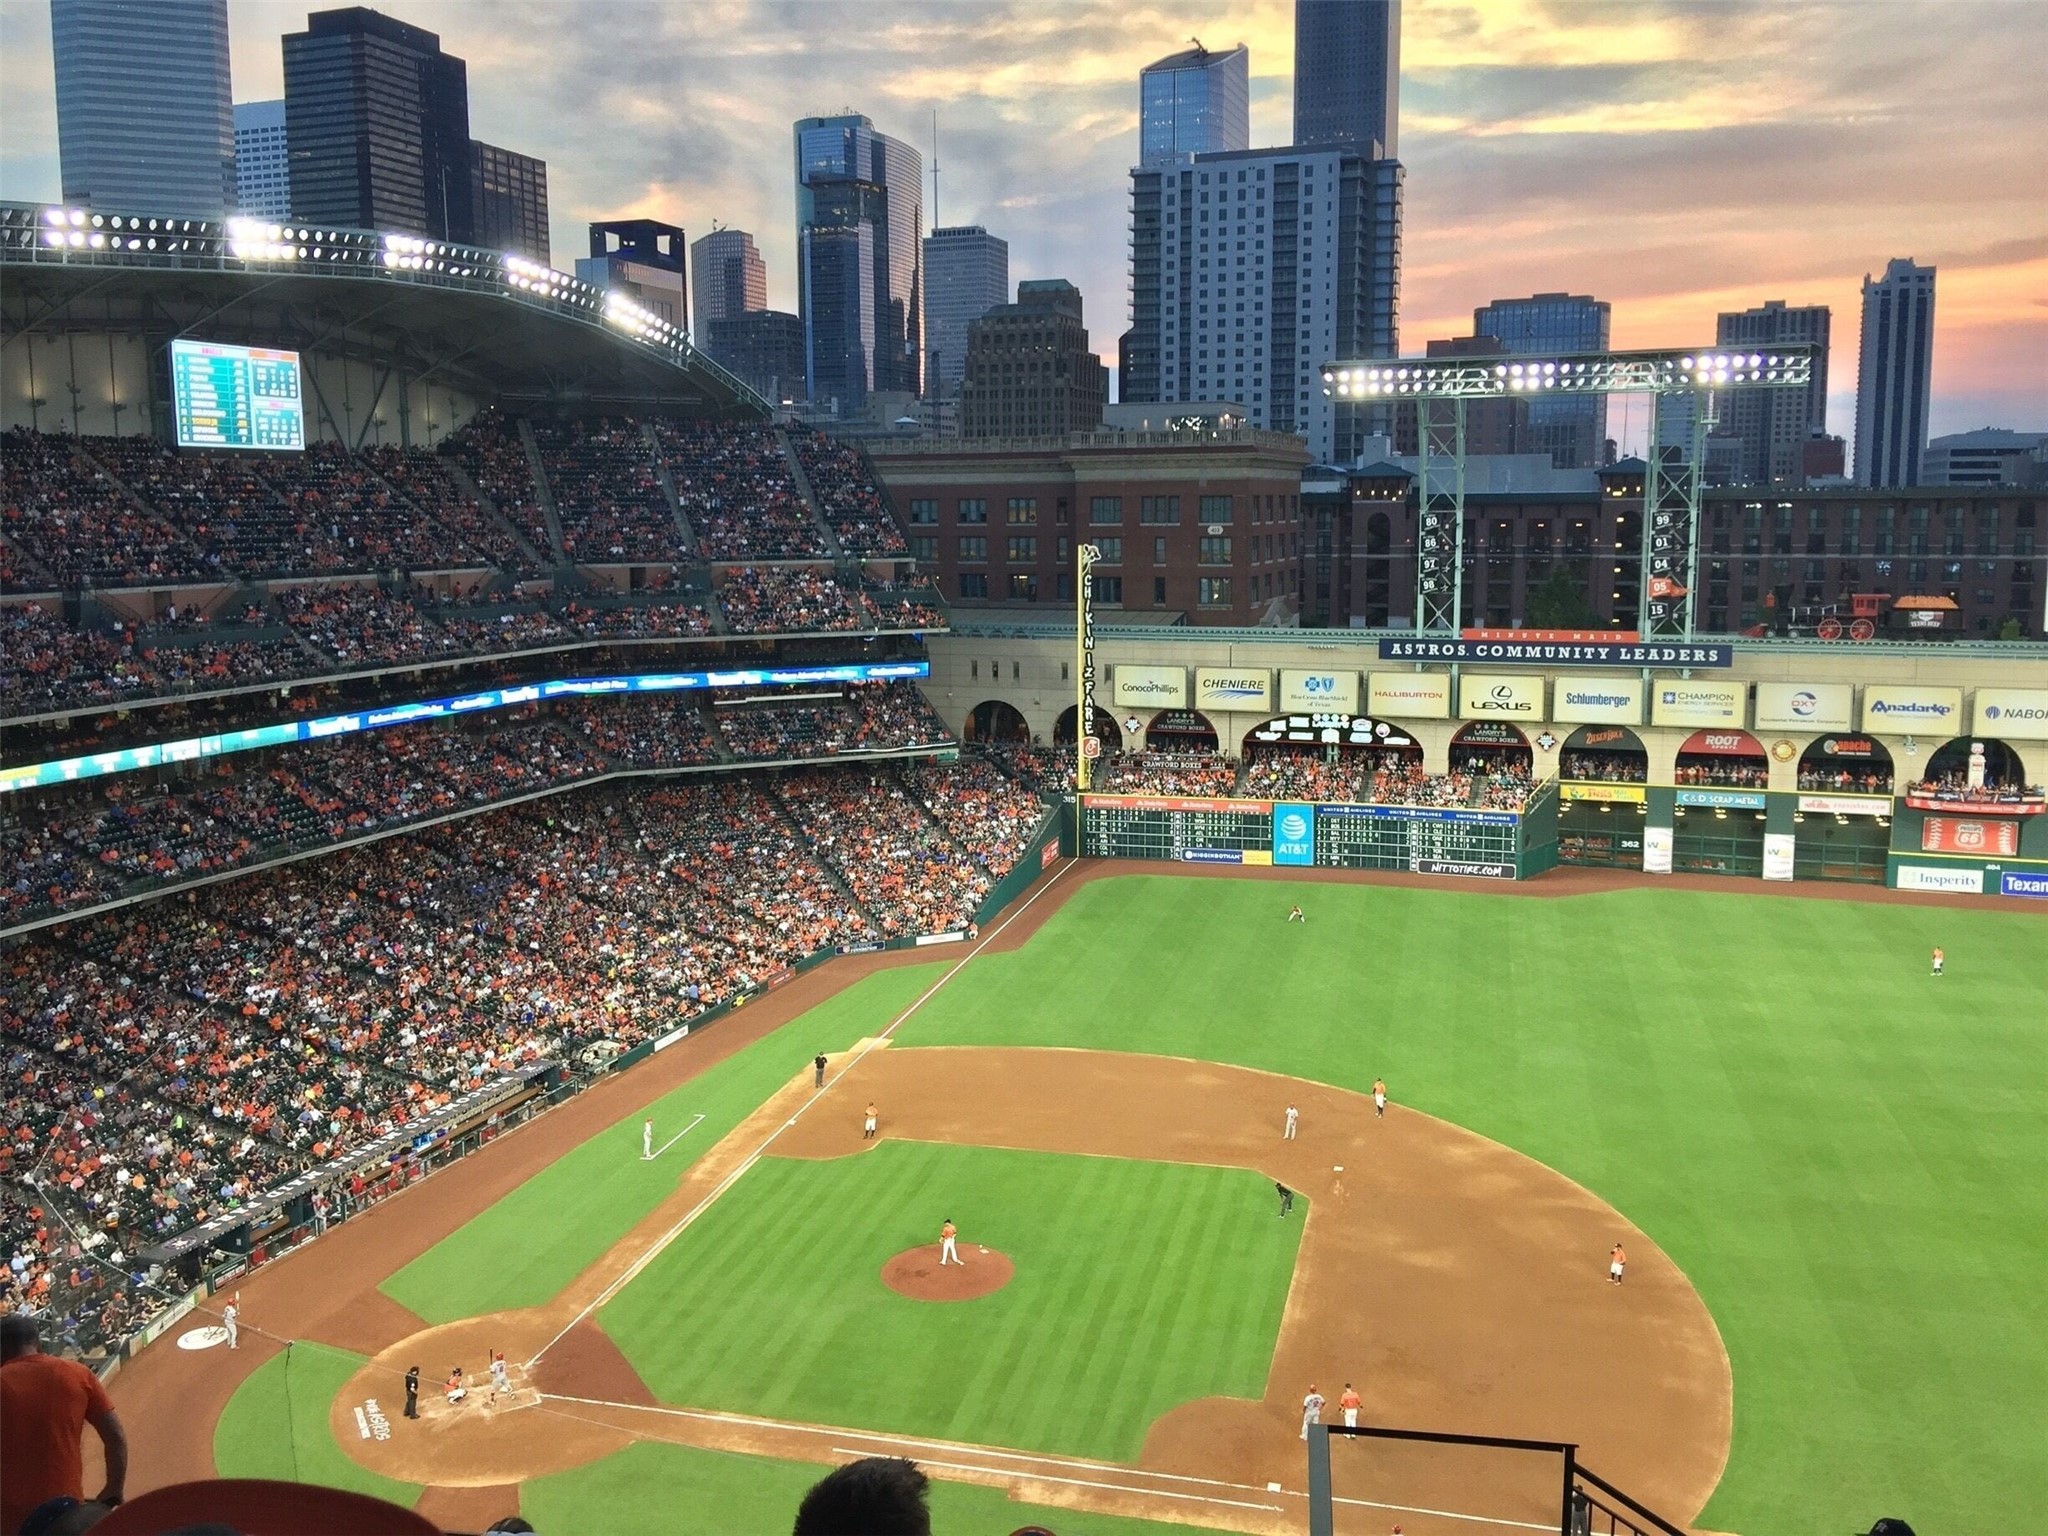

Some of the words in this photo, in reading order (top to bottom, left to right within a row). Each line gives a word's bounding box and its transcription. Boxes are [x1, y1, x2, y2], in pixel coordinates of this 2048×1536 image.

[1426, 517, 1437, 526] 80
[1656, 515, 1669, 525] 99
[1425, 538, 1436, 547] 86
[1655, 537, 1668, 547] 01
[1424, 559, 1435, 568] 97
[1654, 559, 1667, 568] 04
[1423, 580, 1435, 589] 98
[1654, 582, 1666, 591] 05
[1084, 574, 1095, 649] CHIKIN
[1651, 605, 1663, 615] 15
[1481, 631, 1554, 639] MINUTE
[1573, 633, 1622, 641] MAID
[1476, 645, 1610, 660] COMMUNITY
[1619, 647, 1719, 662] LEADERS
[1084, 652, 1093, 678] IZ
[1122, 682, 1179, 696] ConocoPhillips
[1203, 679, 1265, 690] CHENIERE
[1375, 691, 1443, 699] HALLIBURTON
[1566, 692, 1630, 708] Schlumberger
[1678, 692, 1734, 701] CHAMPION
[1084, 681, 1095, 735] FARE
[1471, 701, 1532, 711] LEXUS
[1870, 700, 1951, 716] Anadarko
[1705, 735, 1741, 746] ROOT
[1837, 740, 1872, 751] apache
[1142, 761, 1179, 769] CRAWFORD
[1734, 797, 1759, 805] METAL
[1959, 833, 1980, 843] 66
[1278, 844, 1309, 856] AT&T
[1431, 862, 1502, 877] NITTOTIRE.COM
[1919, 873, 1977, 887] Insperity
[430, 1077, 513, 1116] WELCOME
[325, 1131, 402, 1168] MINUTE
[266, 1171, 324, 1198] MAID
[200, 1201, 262, 1230] PARK
